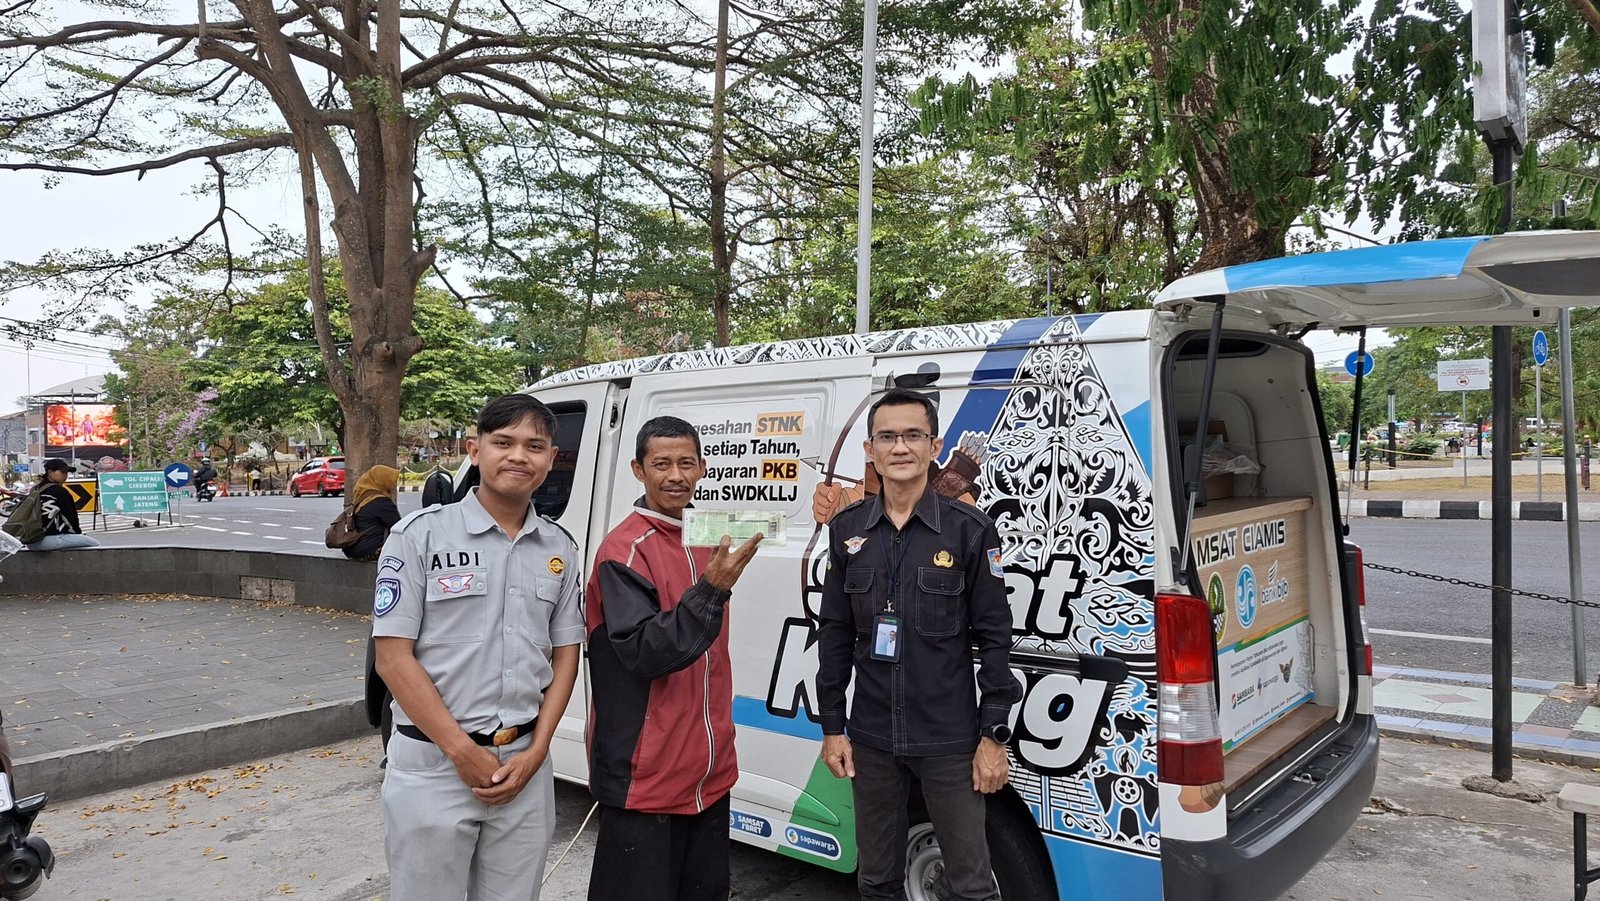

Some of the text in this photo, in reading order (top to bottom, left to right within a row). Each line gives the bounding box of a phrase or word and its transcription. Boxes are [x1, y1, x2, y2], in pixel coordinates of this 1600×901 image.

[757, 415, 803, 433] STNK
[703, 439, 800, 459] setiap Tahun,
[762, 462, 798, 479] PKB
[693, 485, 798, 502] dan SWDKLLJ
[431, 552, 479, 571] ALDI
[800, 835, 836, 851] sapawarga
